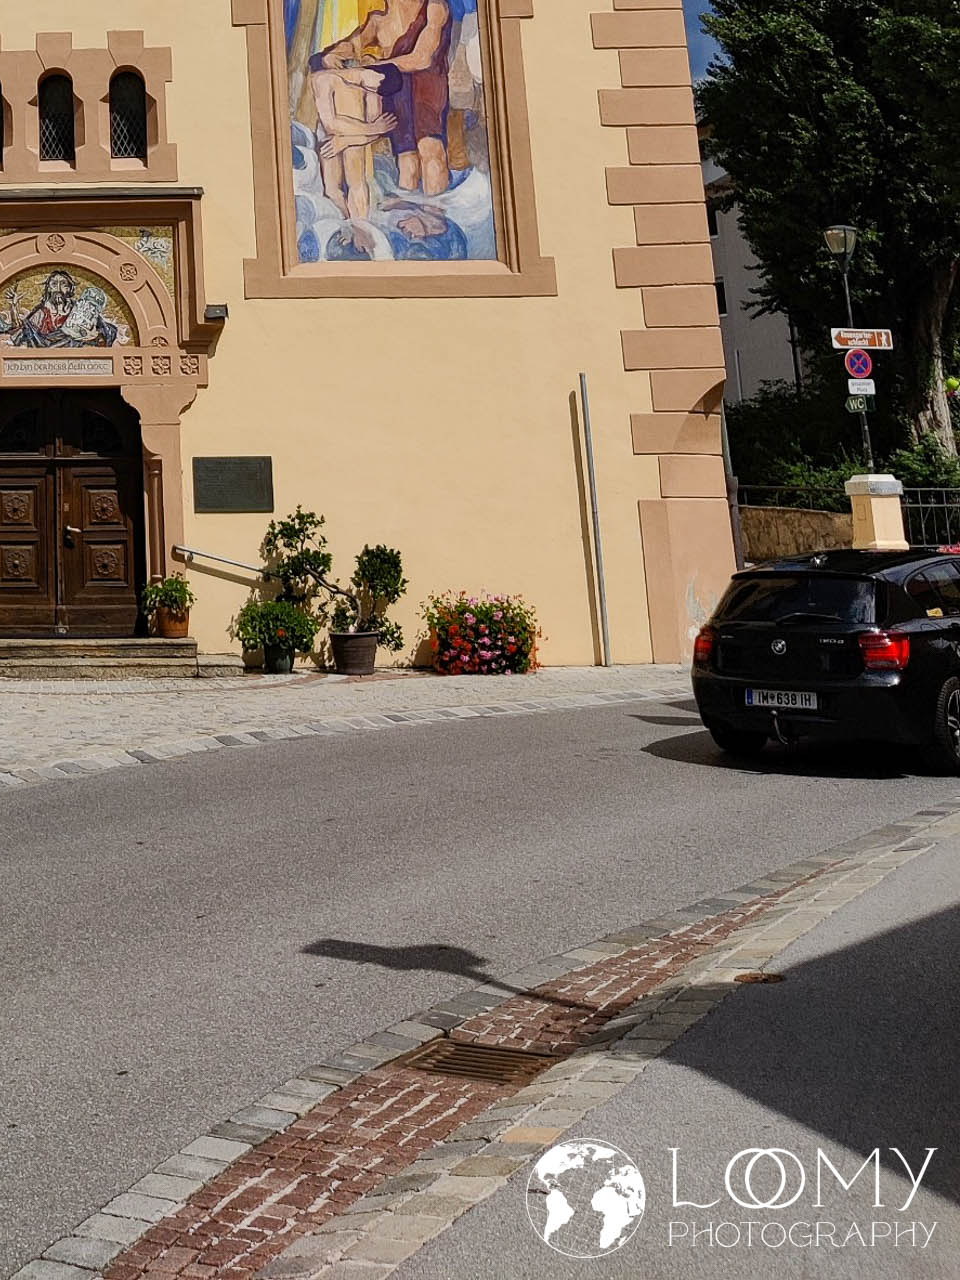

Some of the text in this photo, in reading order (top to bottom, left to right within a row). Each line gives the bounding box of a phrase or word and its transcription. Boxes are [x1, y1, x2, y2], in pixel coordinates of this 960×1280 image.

[849, 398, 865, 410] WC
[758, 691, 812, 707] IM 638 IH
